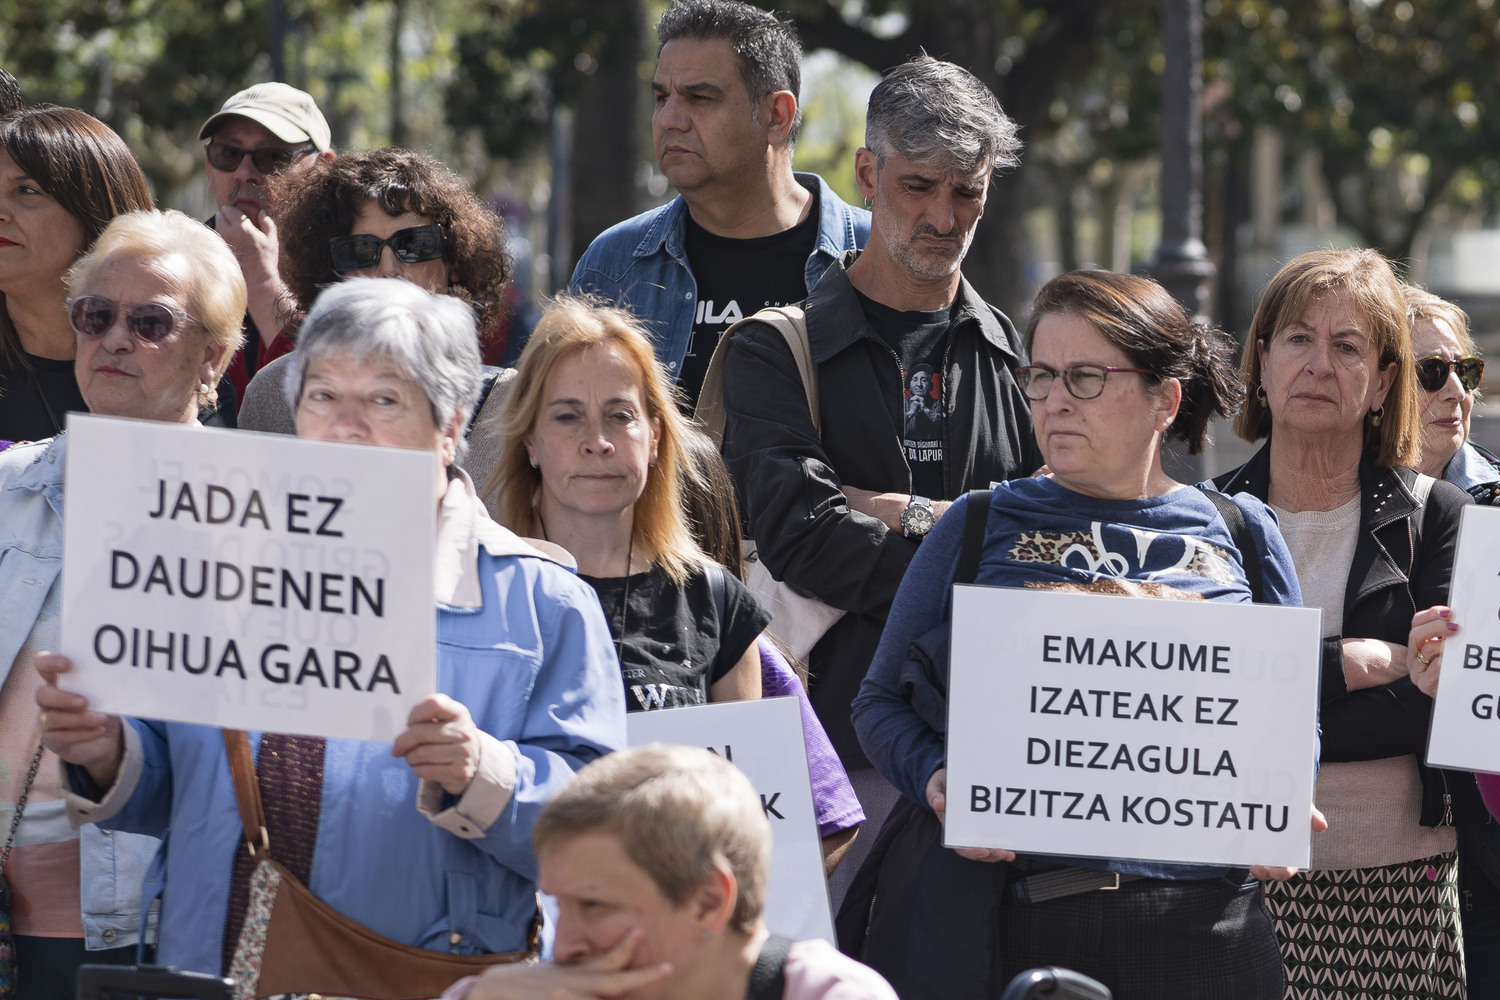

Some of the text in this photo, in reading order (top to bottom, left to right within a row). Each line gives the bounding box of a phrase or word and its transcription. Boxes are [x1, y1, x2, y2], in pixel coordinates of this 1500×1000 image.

[695, 300, 743, 325] ILA
[149, 479, 344, 538] JADA EZ
[110, 549, 384, 618] DAUDENEN
[93, 624, 402, 695] OIHUA GARA
[1042, 634, 1232, 675] EMAKUME
[1030, 685, 1239, 726] IZATEAK EZ
[1027, 737, 1238, 778] DIEZAGULA
[970, 784, 1290, 833] BIZITZA KOSTATU
